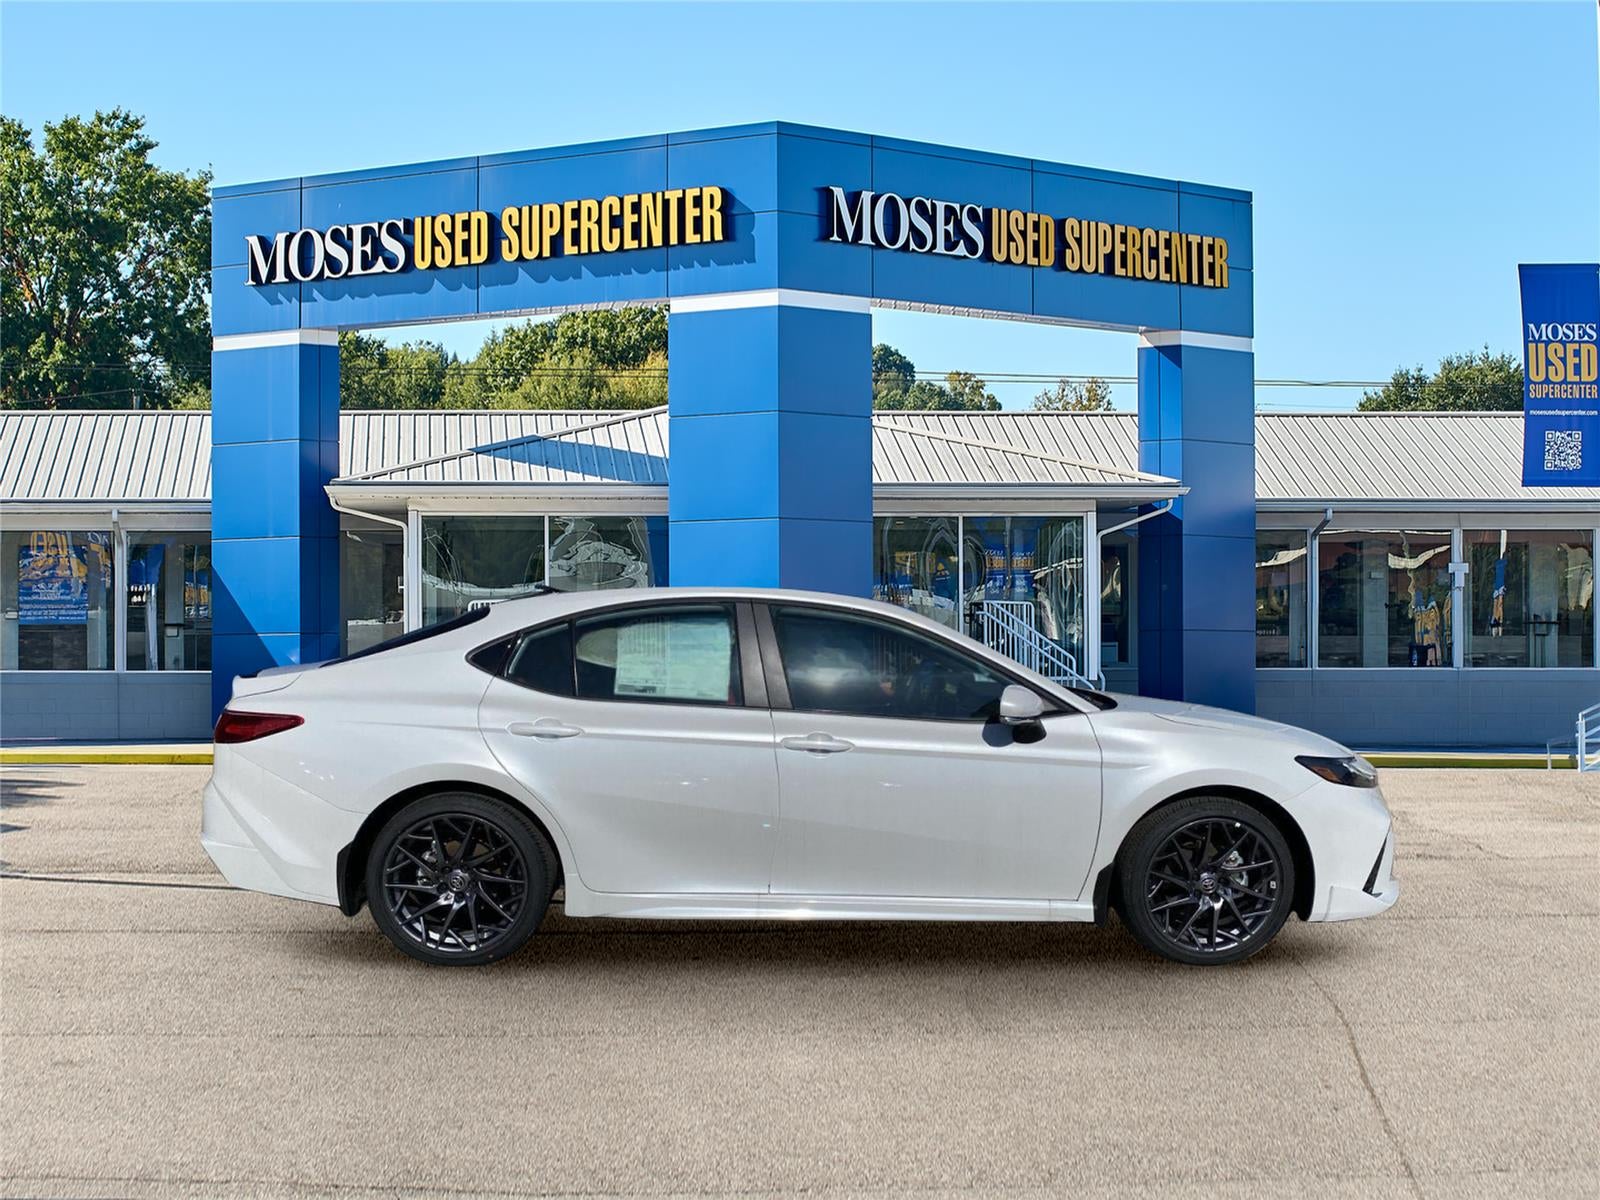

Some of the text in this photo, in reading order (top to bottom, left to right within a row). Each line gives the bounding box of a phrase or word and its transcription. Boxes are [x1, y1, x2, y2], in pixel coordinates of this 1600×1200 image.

[244, 186, 724, 286] MOSES USED SUPERCENTER
[828, 186, 1229, 288] MOSES USED SUPERCENTER
[1527, 323, 1597, 341] MOSES
[1528, 343, 1598, 383] USED
[1529, 384, 1598, 399] SUPERCENTER
